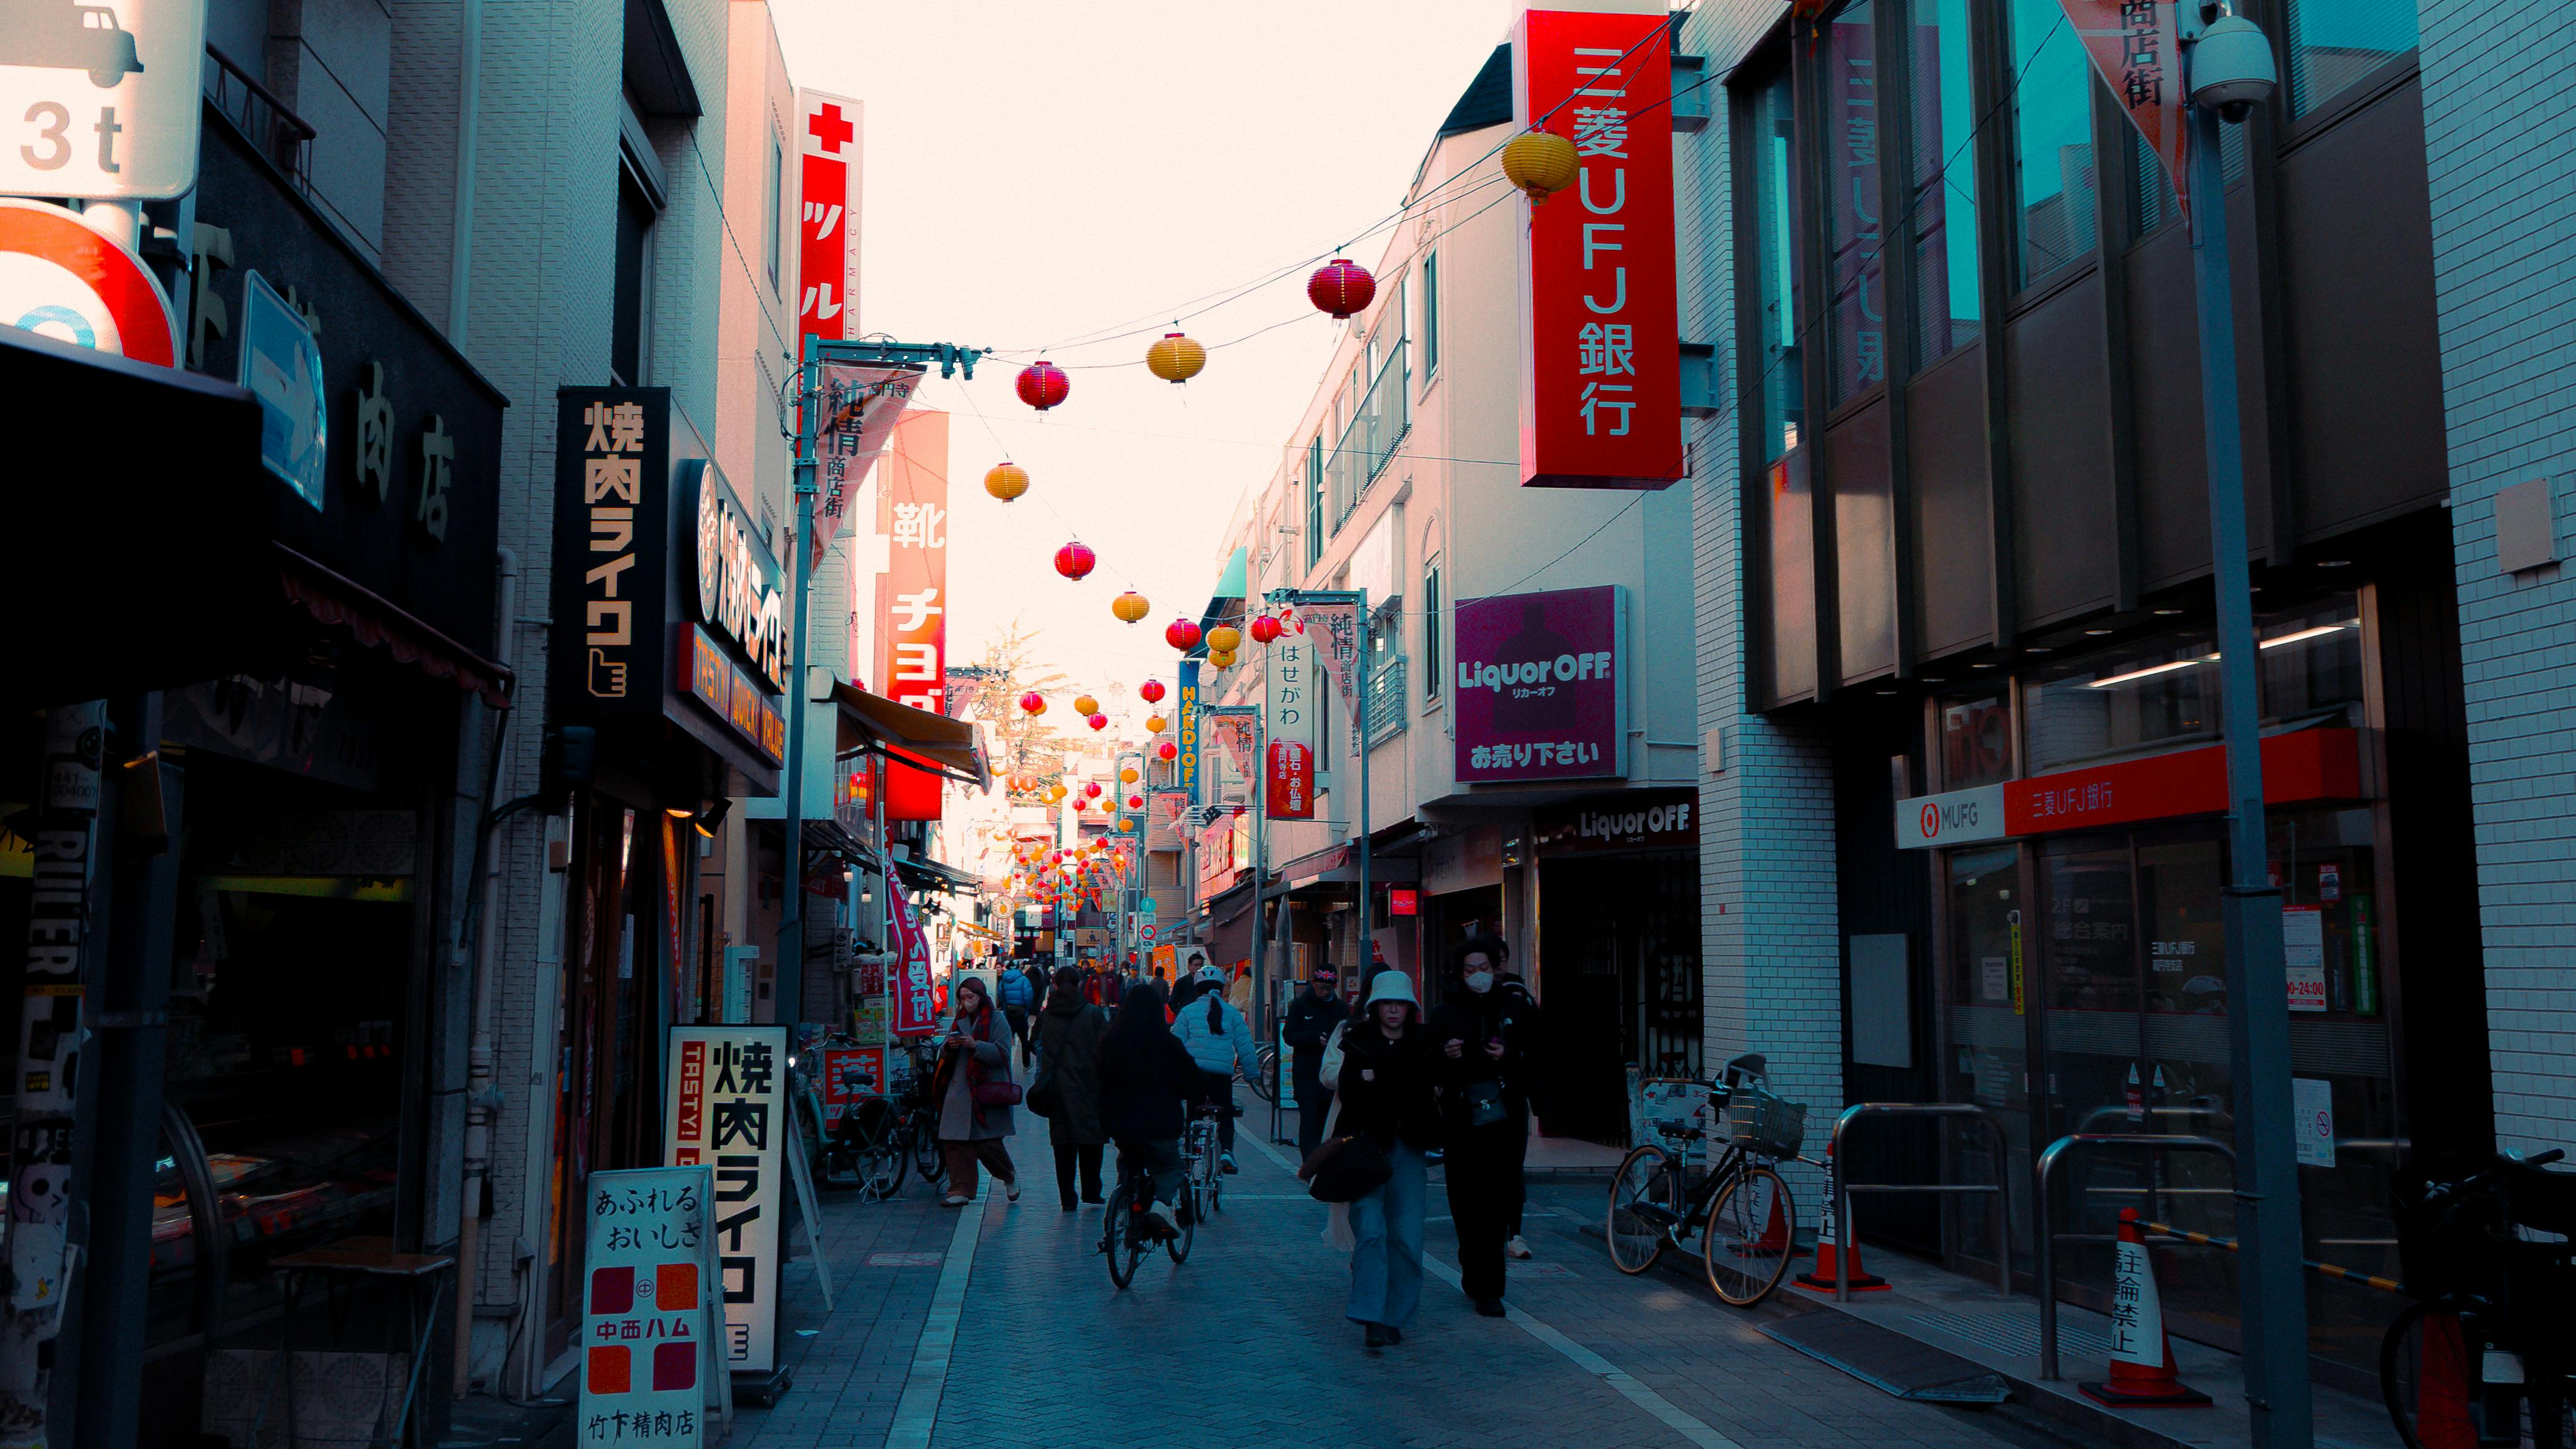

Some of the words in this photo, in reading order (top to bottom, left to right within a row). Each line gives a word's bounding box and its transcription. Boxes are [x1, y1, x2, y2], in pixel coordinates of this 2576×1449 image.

[801, 200, 843, 320] ツル
[1573, 47, 1636, 435] 三菱UFJ銀行
[847, 209, 857, 335] HARMACY
[584, 402, 644, 645] 焼肉ライク
[893, 502, 945, 549] 靴
[696, 635, 729, 715] TASTY!
[1280, 645, 1300, 725] はせがわ
[1512, 686, 1555, 699] リカーオフ
[1471, 741, 1599, 769] お売り下さい
[1942, 802, 1978, 831] MUFG
[2032, 781, 2114, 819] 三菱UFJ銀行
[681, 1046, 701, 1135] TASTY!
[595, 1186, 698, 1217] あふれる
[606, 1222, 701, 1250] おいしさ
[596, 1318, 691, 1340] 中西ハム
[588, 1409, 694, 1445] 竹下精肉店
